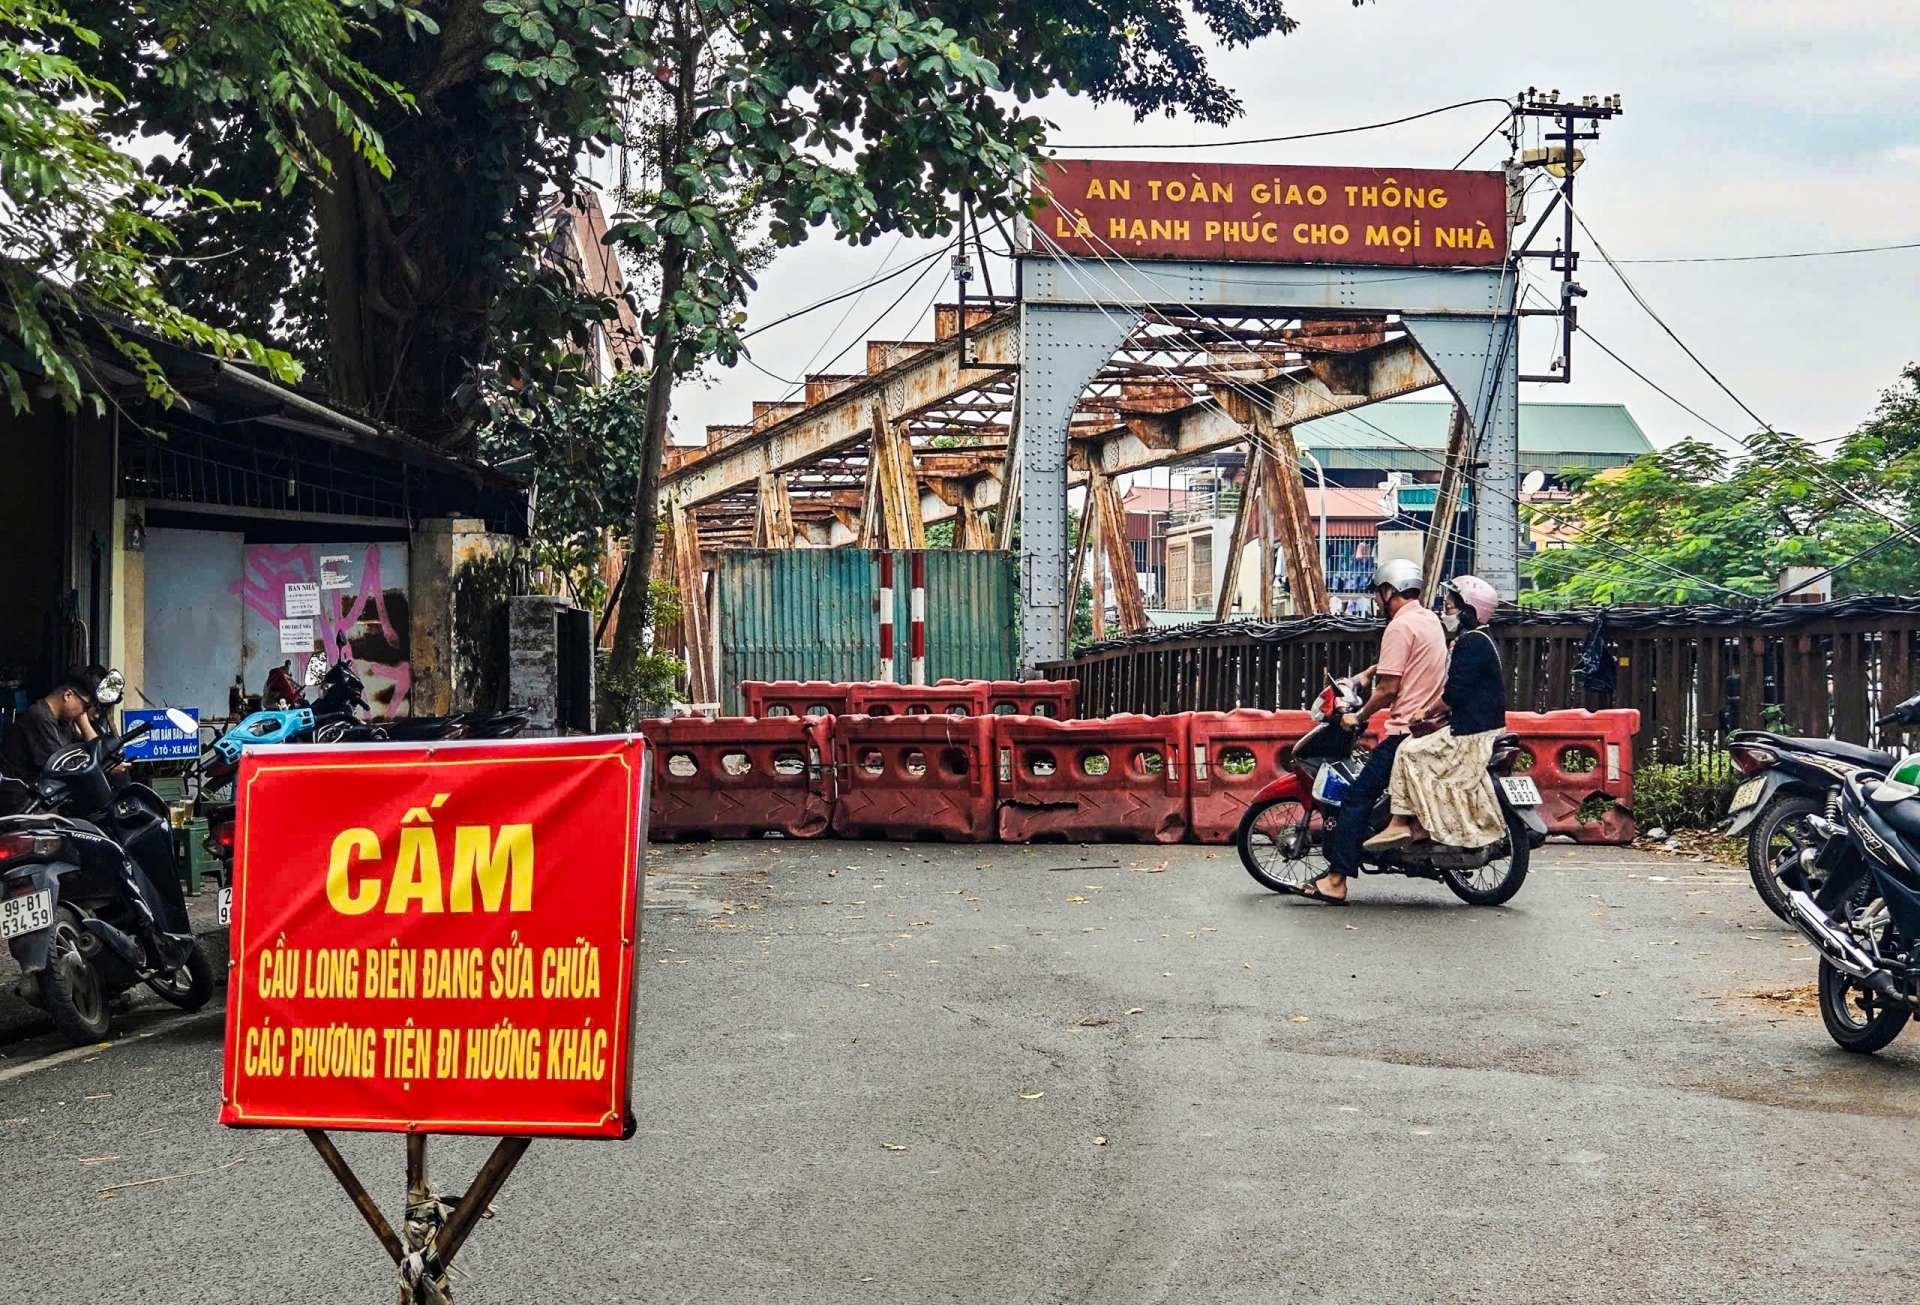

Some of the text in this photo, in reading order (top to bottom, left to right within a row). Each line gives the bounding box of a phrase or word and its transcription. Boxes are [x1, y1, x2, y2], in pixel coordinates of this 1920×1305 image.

[1087, 179, 1131, 200] AN
[1149, 173, 1233, 203] TOÀN
[1345, 177, 1448, 209] THÔNG
[1056, 208, 1093, 239] LÀ
[1109, 218, 1190, 246] HẠNH
[1205, 211, 1278, 243] PHÚC
[1293, 223, 1350, 245] CHO
[1436, 220, 1496, 249] NHÀ
[326, 793, 535, 916] CẤM
[2, 909, 49, 937] 534.59
[4, 893, 41, 918] 99-B1
[259, 930, 601, 999] CẦU LONG BIÊN ĐANG SỬA CHỮA
[245, 1017, 608, 1091] CÁC PHƯƠNG TIỆN ĐI HƯỚNG KHÁC
